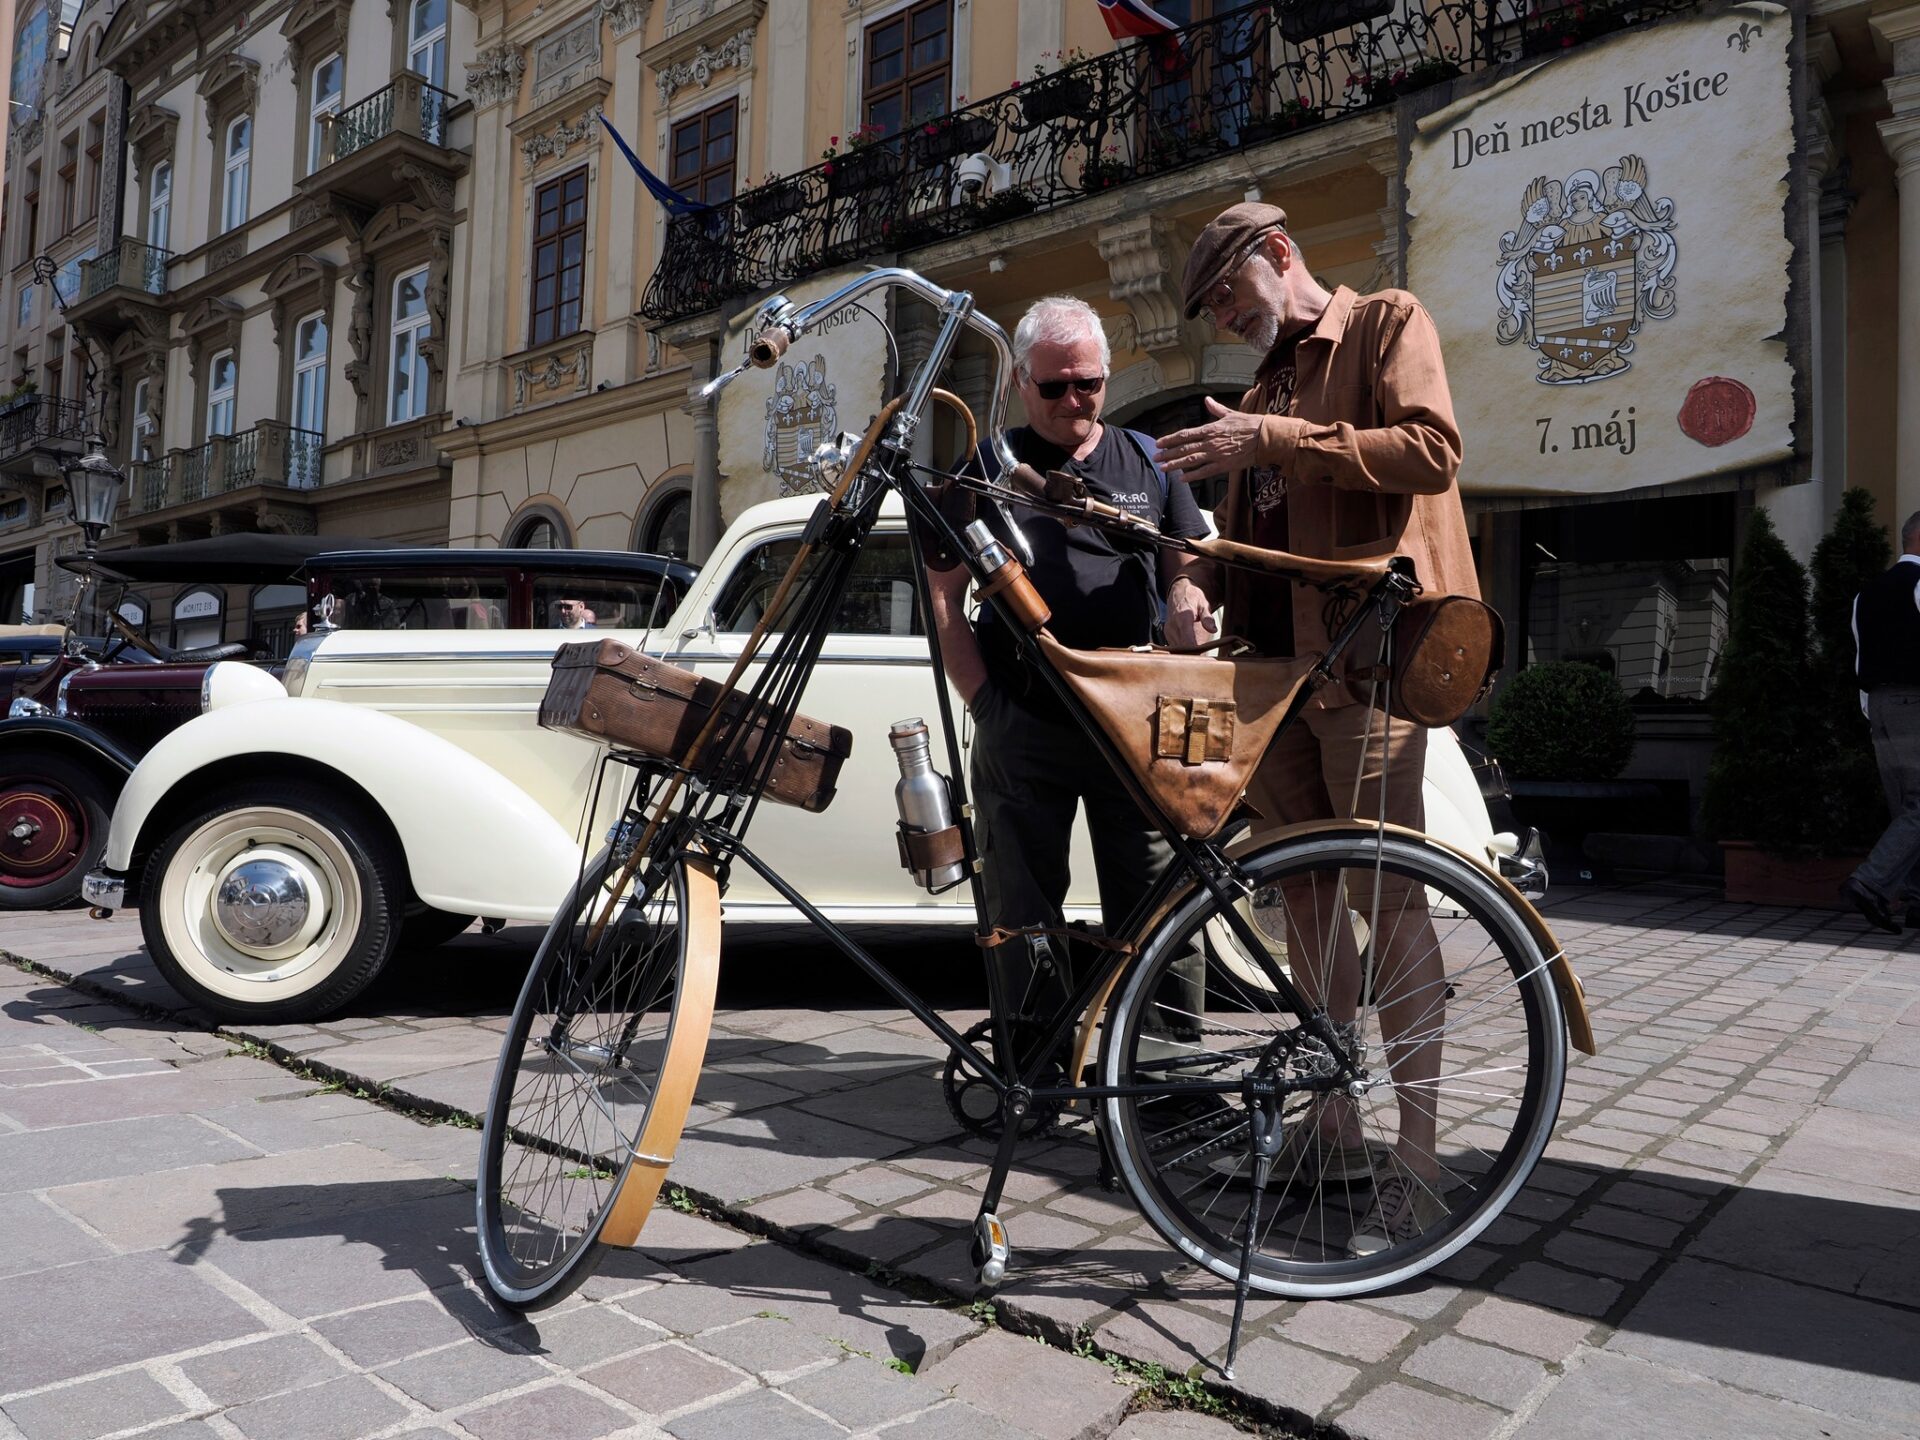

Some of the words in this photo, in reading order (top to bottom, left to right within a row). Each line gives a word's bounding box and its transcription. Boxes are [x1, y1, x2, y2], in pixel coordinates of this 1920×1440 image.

[1451, 120, 1511, 169] Deň
[1520, 96, 1612, 148] mesta
[1623, 68, 1730, 128] Košice
[1535, 417, 1559, 455] 7.
[1571, 405, 1637, 456] máj
[183, 603, 203, 614] MORITZ
[204, 602, 212, 611] EIS
